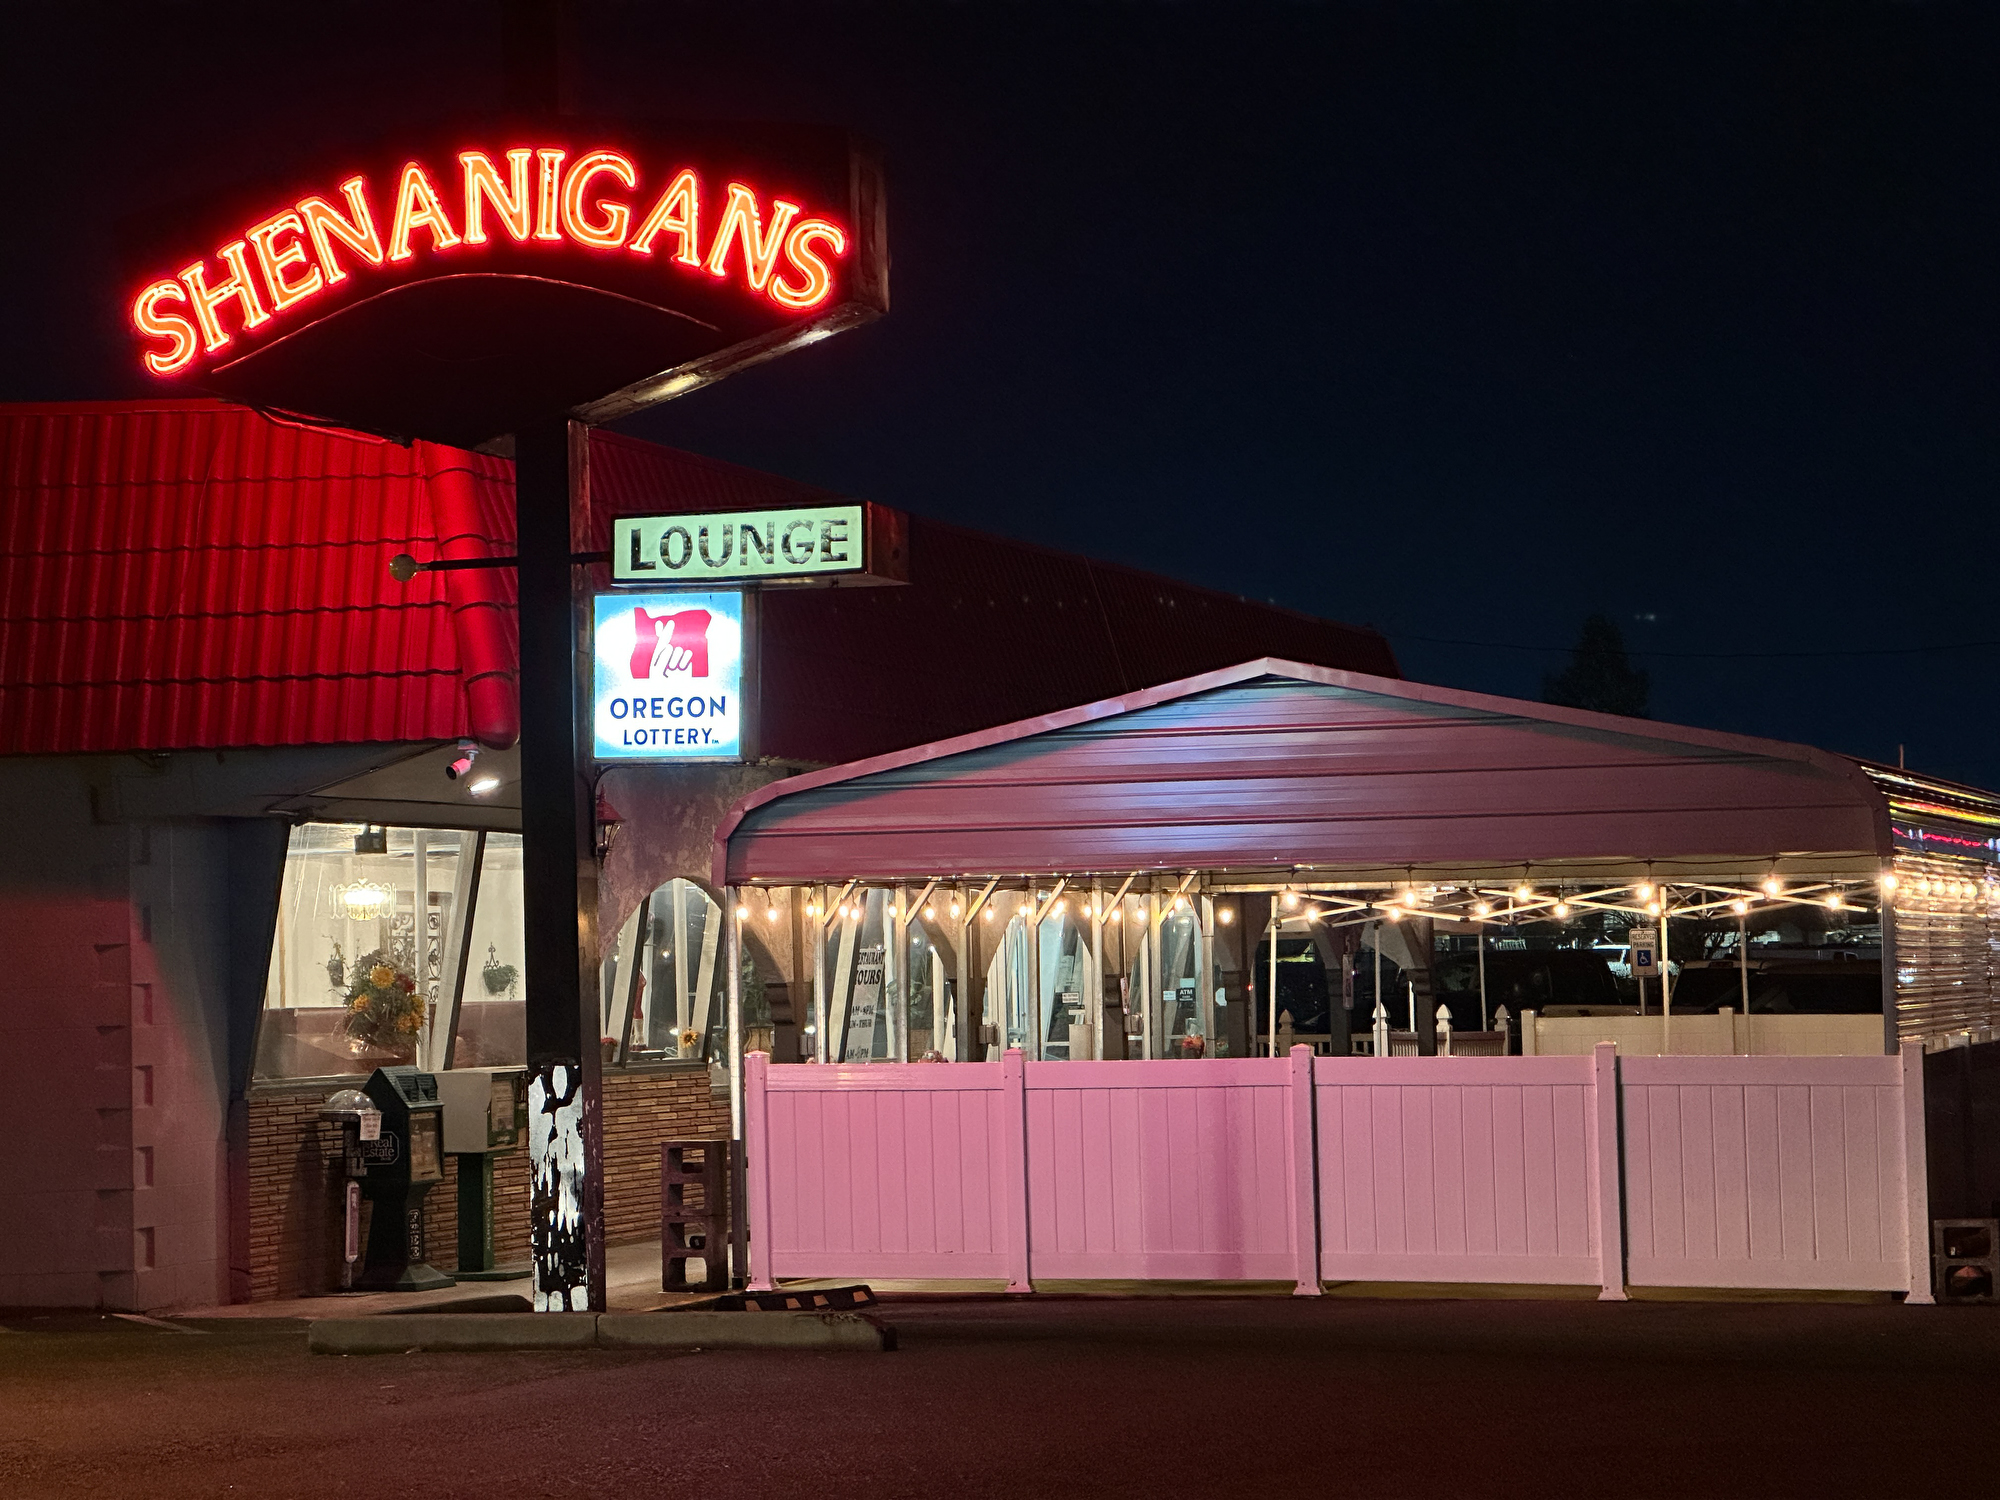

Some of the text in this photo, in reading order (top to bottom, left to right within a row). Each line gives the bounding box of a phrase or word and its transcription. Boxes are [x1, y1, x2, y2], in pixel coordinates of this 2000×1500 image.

[133, 147, 847, 376] SHENANIGANS
[629, 518, 849, 572] LOUNGE
[610, 696, 726, 719] OREGON
[623, 728, 712, 745] LOTTERY
[858, 951, 885, 965] ESTAURANT
[370, 1135, 392, 1148] Real
[363, 1148, 395, 1157] Estate
